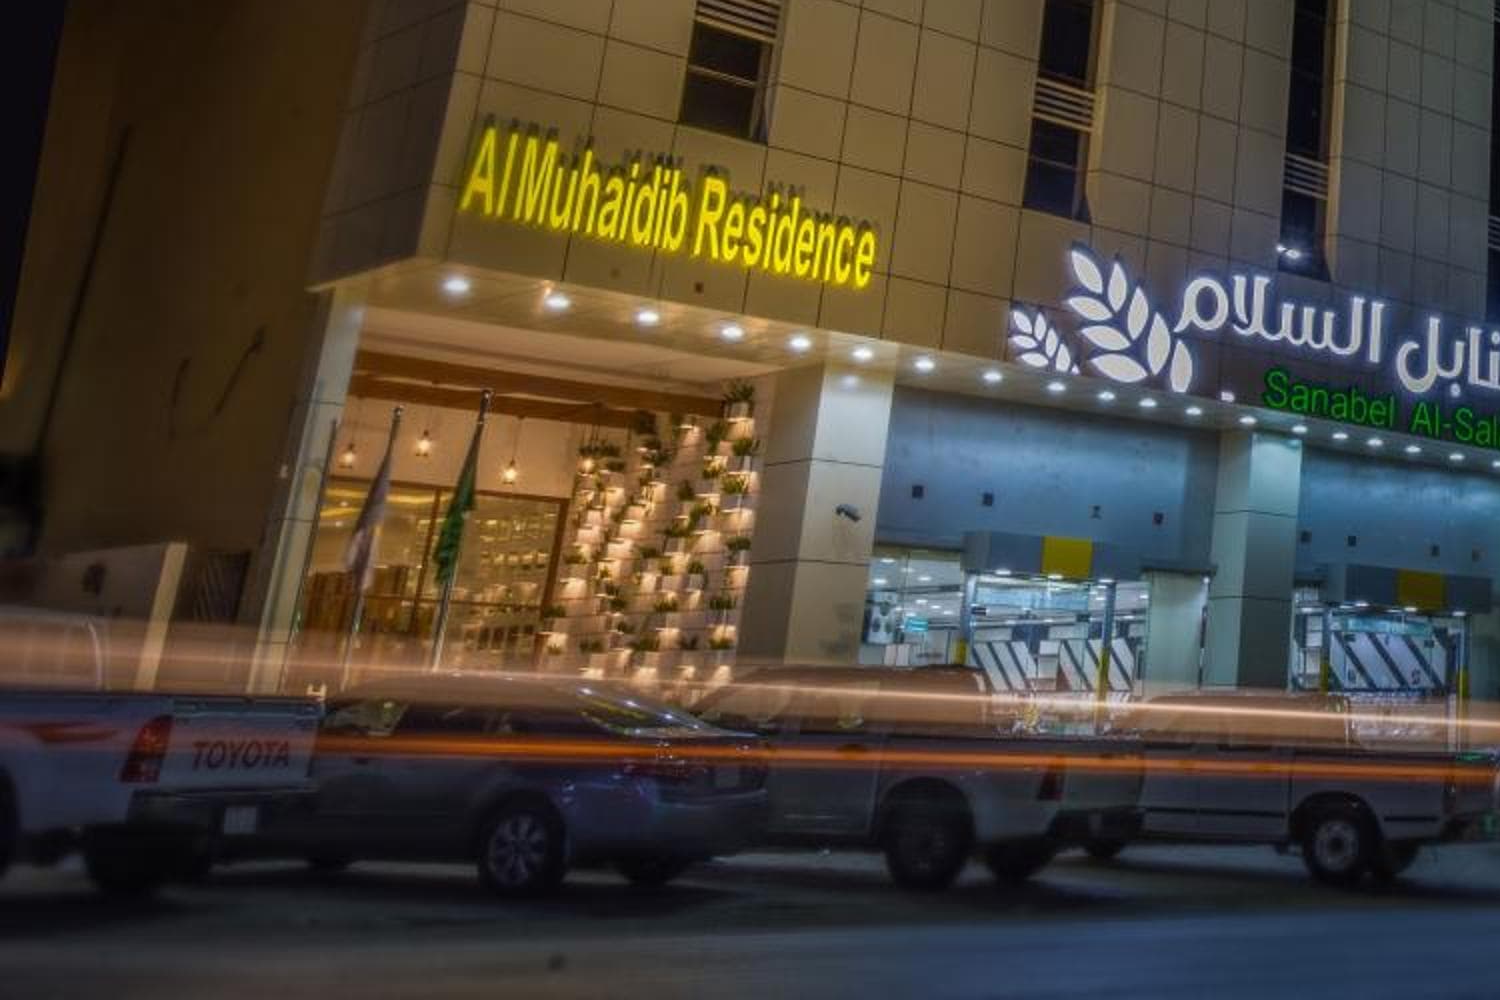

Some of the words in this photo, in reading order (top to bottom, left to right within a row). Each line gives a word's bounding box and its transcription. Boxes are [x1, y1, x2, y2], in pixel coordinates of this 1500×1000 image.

[461, 127, 517, 218] Al
[514, 136, 689, 252] Muhaidib
[694, 176, 877, 289] Residence
[1175, 274, 1386, 364] السلام
[1264, 370, 1395, 428] Sanabel
[192, 740, 290, 770] TOYOTA
